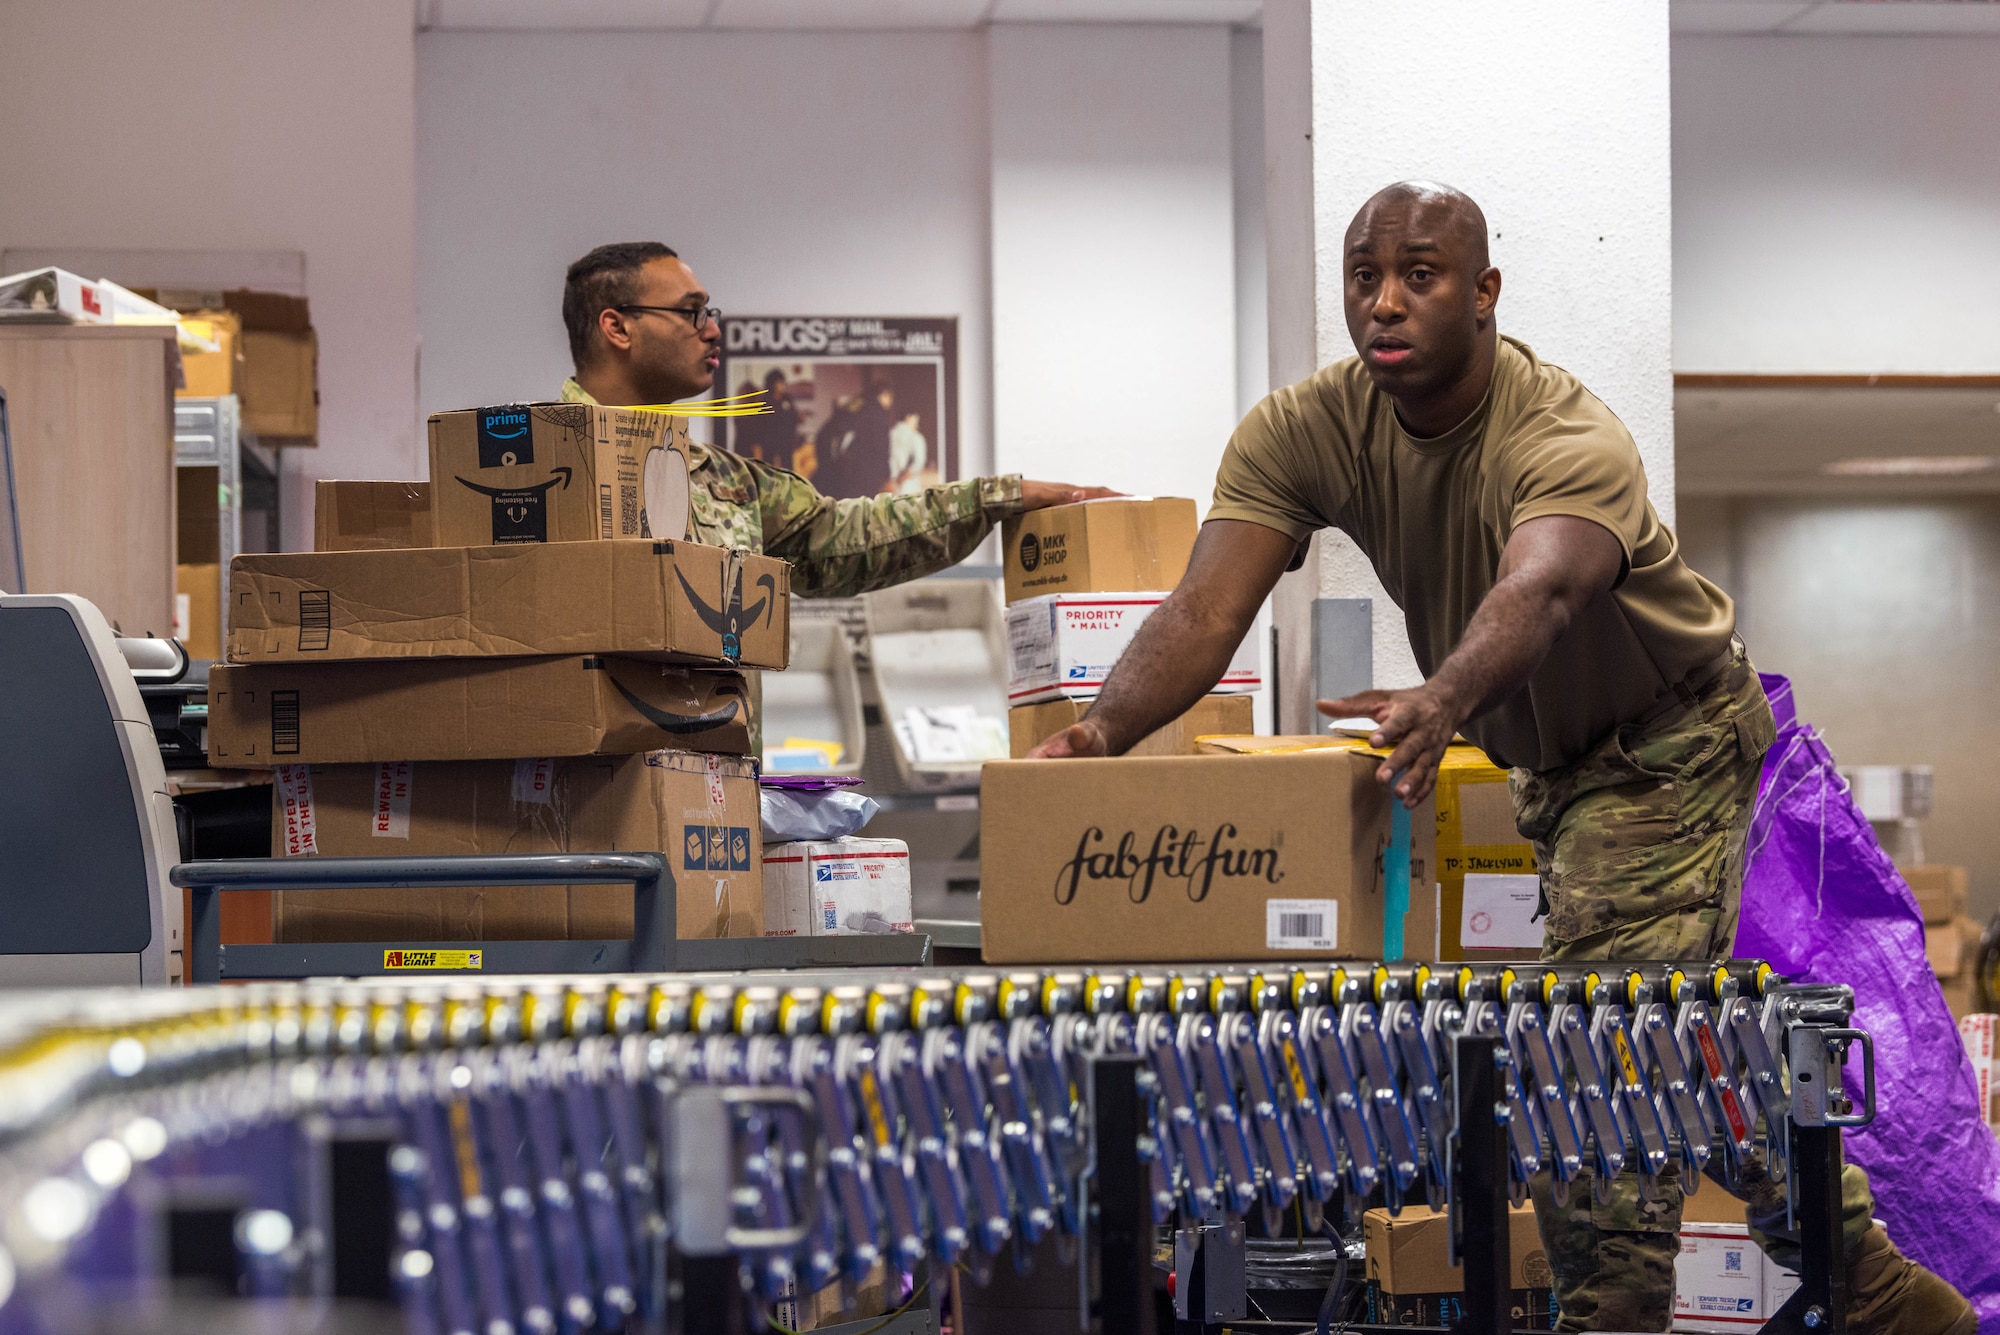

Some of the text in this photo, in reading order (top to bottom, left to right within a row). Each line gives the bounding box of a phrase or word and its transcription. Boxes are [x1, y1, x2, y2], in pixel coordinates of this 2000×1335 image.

[727, 320, 827, 350] DRUGS
[485, 412, 527, 430] prime
[615, 413, 627, 424] Create
[616, 427, 655, 441] augmented reality
[616, 439, 632, 449] pumpkin
[495, 497, 524, 505] listening
[1043, 534, 1065, 549] MKK
[1043, 550, 1067, 565] SHOP
[1066, 610, 1124, 620] PRIORITY
[1080, 622, 1110, 630] MAIL
[395, 761, 408, 798] IN TH
[378, 761, 393, 831] REWRAPP
[296, 764, 313, 849] IN THE U.S.
[1467, 857, 1523, 870] JACKLYNN
[403, 952, 437, 960] LITTLE
[1699, 1026, 1719, 1071] POWER
[1439, 1297, 1449, 1327] rime
